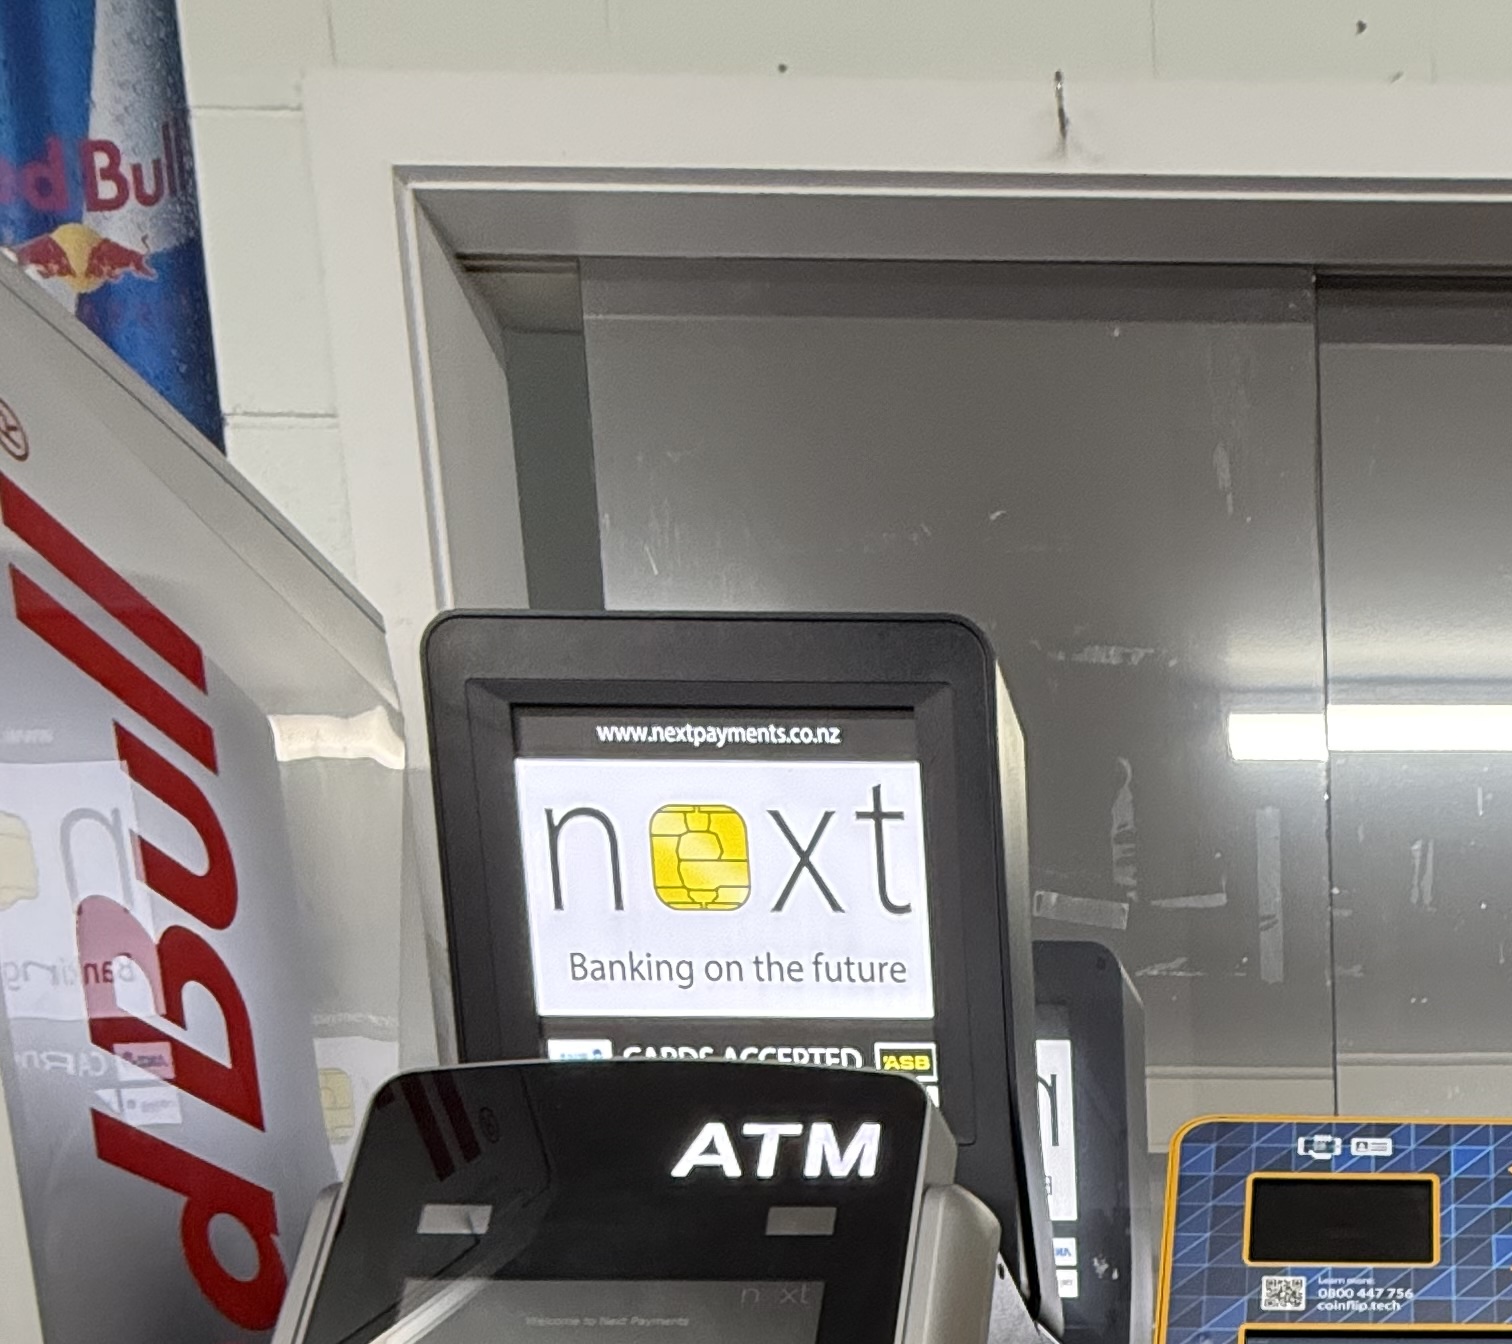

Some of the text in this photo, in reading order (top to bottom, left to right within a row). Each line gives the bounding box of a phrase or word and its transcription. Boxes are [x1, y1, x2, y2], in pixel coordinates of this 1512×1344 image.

[596, 723, 841, 748] www.nextpayments.co.nz
[0, 468, 265, 1132] Bull
[544, 784, 912, 915] next
[569, 952, 907, 989] Banking on the future
[671, 1121, 883, 1178] ATM
[1317, 1300, 1402, 1312] coinflip.tech
[1318, 1288, 1414, 1299] 0800 447 756
